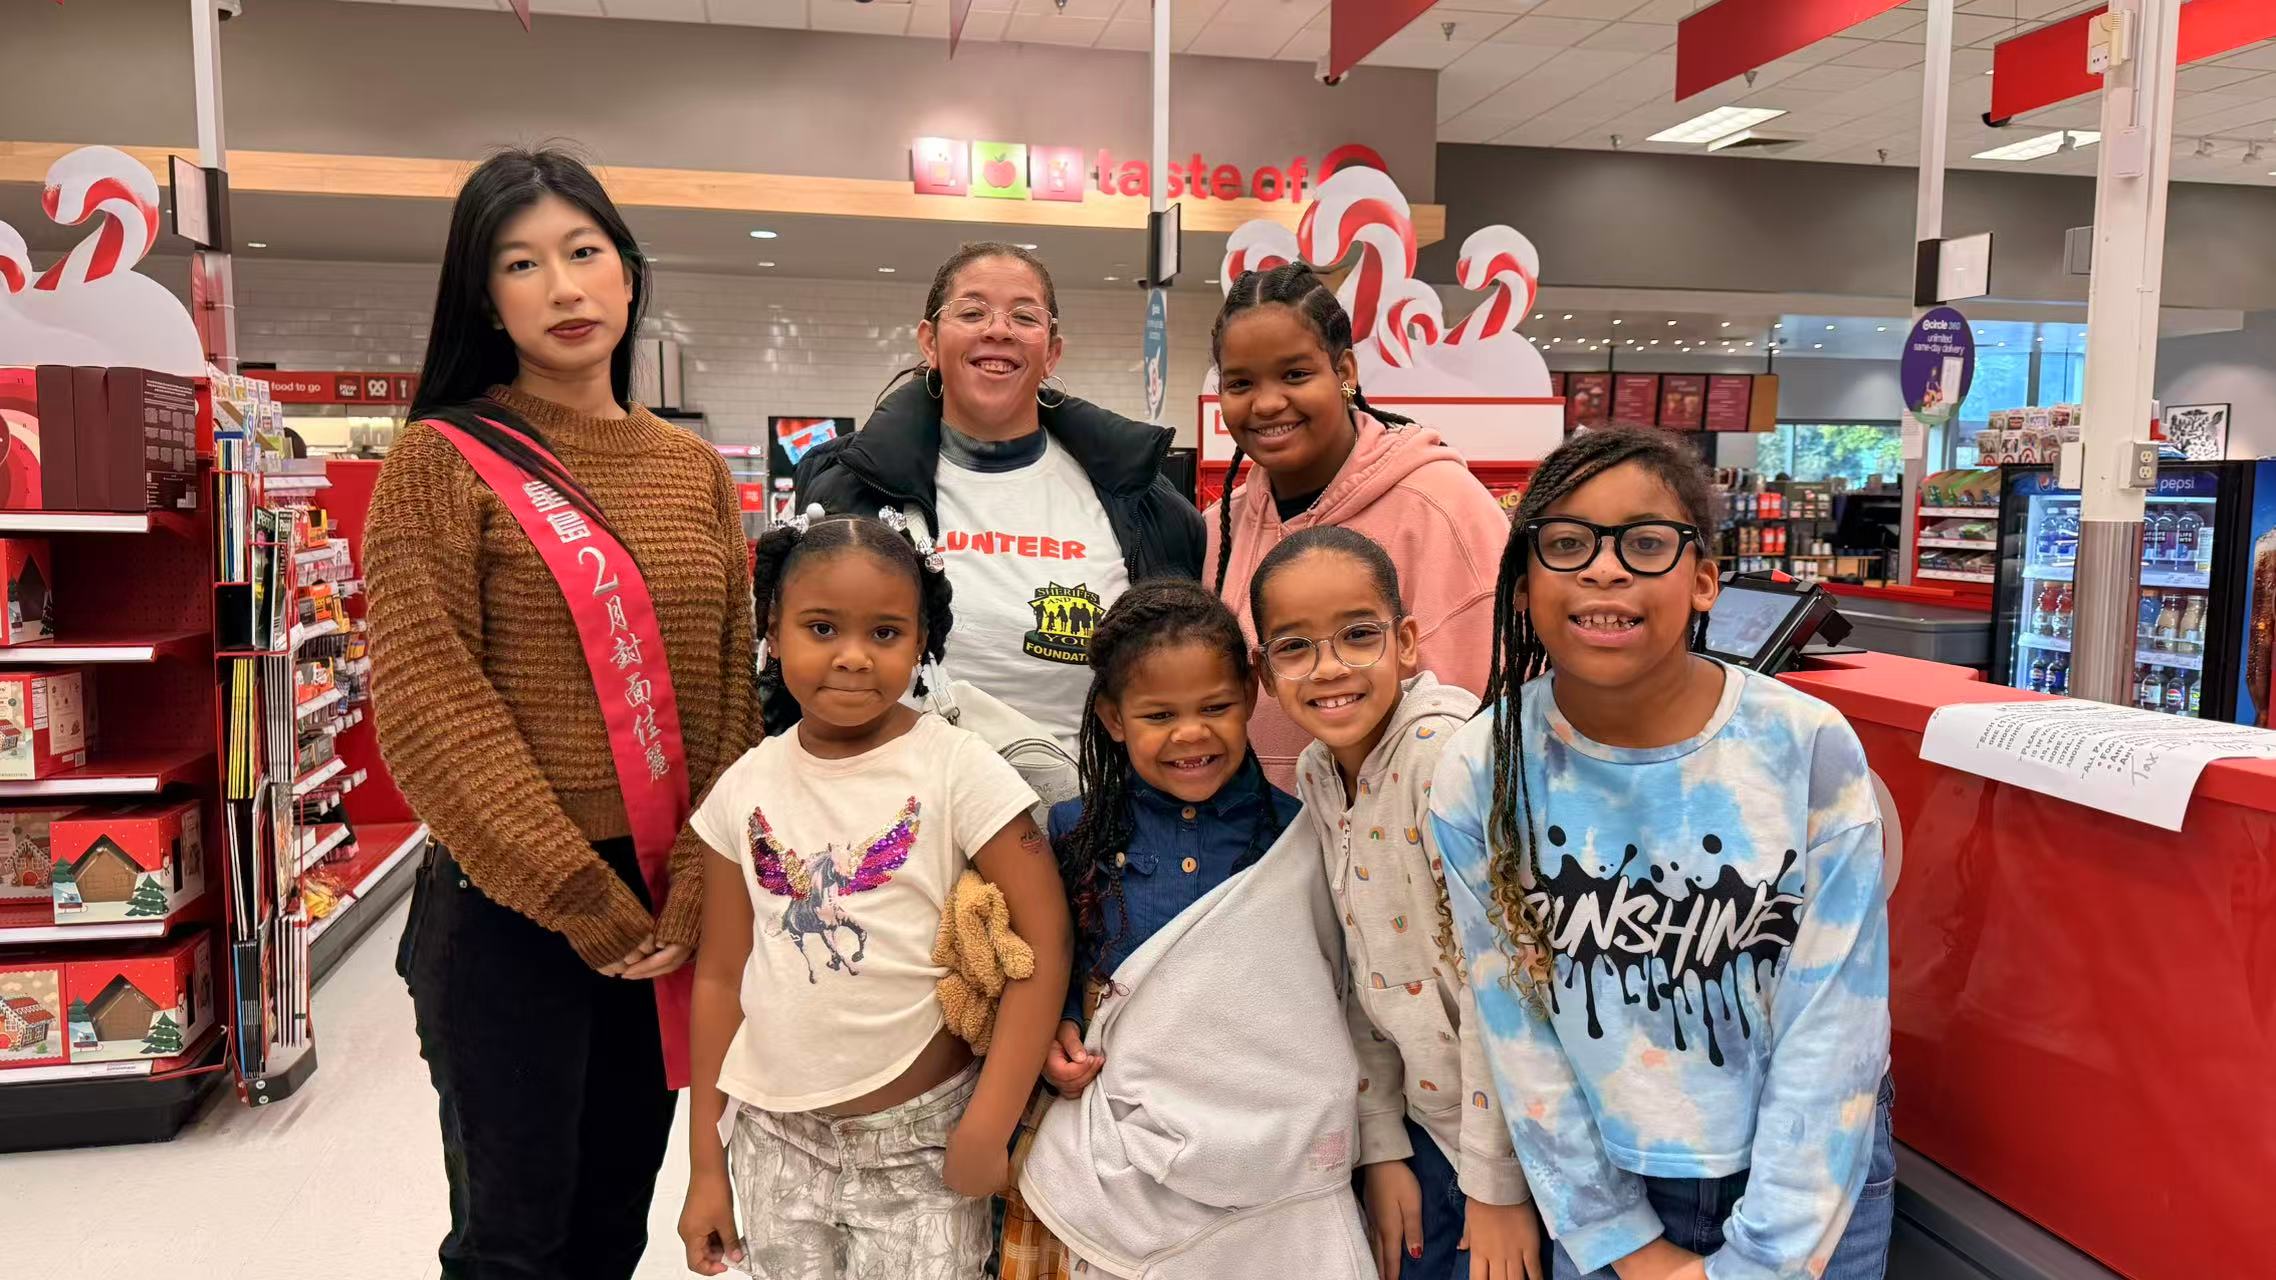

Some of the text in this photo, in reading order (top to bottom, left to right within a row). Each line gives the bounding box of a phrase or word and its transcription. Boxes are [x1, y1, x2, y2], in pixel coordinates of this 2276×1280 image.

[1096, 148, 1309, 203] taste of
[271, 382, 321, 393] food to go
[2160, 476, 2195, 492] pepsi
[1037, 587, 1098, 603] SHERIFFS
[1047, 597, 1072, 605] AND
[1025, 642, 1089, 662] FOUNDAT
